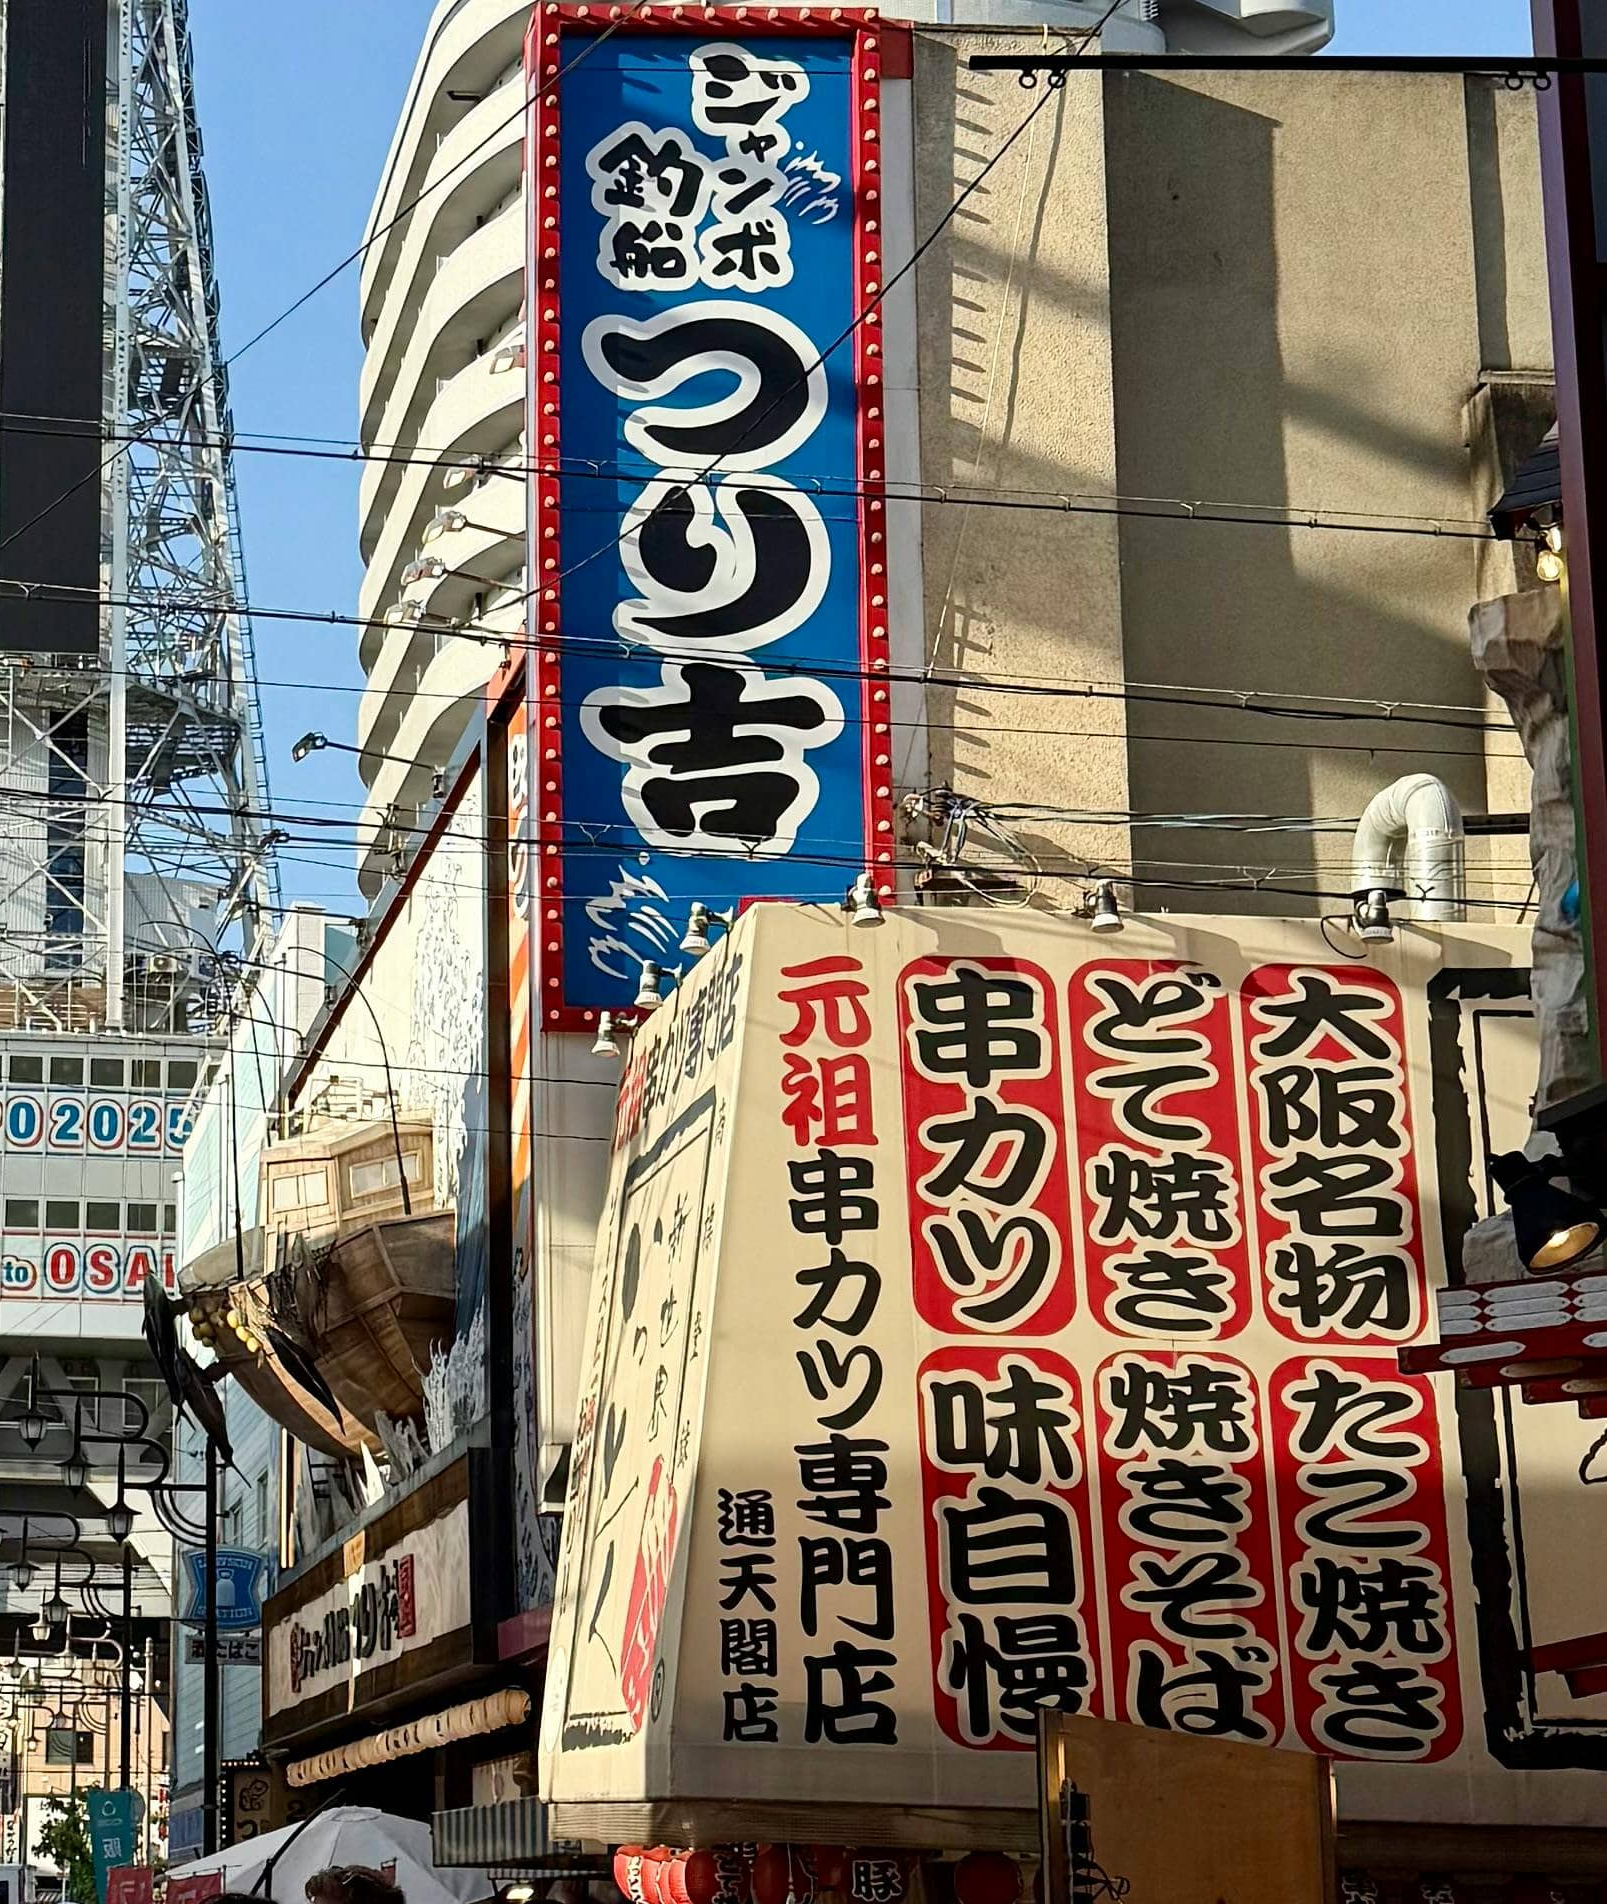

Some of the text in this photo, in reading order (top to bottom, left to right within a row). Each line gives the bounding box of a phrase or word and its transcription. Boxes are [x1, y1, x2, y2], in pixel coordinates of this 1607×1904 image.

[597, 134, 705, 282] 釣船
[598, 325, 829, 840] つり吉
[613, 952, 745, 1156] 元祖串カツ専門店
[913, 968, 1060, 1325] 串カツ
[1084, 972, 1231, 1333] どて焼き
[1252, 978, 1414, 1333] 大阪名物
[5, 1259, 30, 1283] to
[646, 1191, 692, 1444] 新世界
[717, 1488, 780, 1746] 通天閣店
[929, 1358, 1089, 1739] 味自慢
[1109, 1362, 1276, 1739] 焼きそば
[1295, 1371, 1448, 1752] たこ焼き
